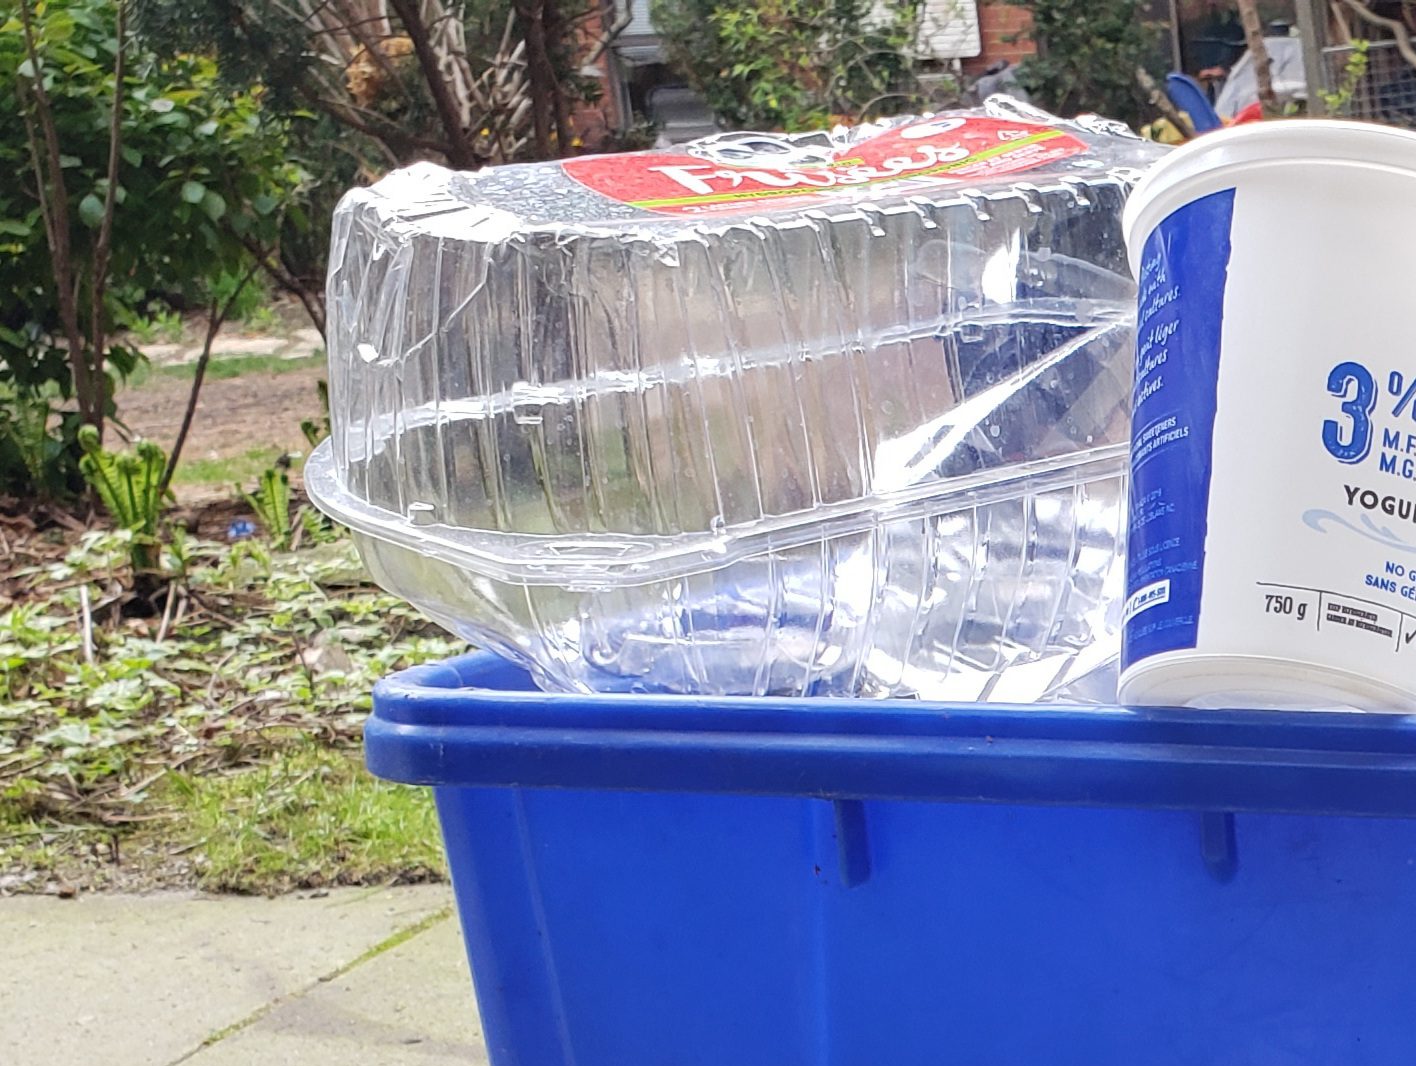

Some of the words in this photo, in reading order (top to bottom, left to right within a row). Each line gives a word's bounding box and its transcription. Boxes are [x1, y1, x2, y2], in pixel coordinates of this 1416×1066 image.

[1385, 561, 1405, 577] NO
[1365, 574, 1397, 593] SANS
[1265, 595, 1293, 614] 750
[1297, 603, 1308, 620] g
